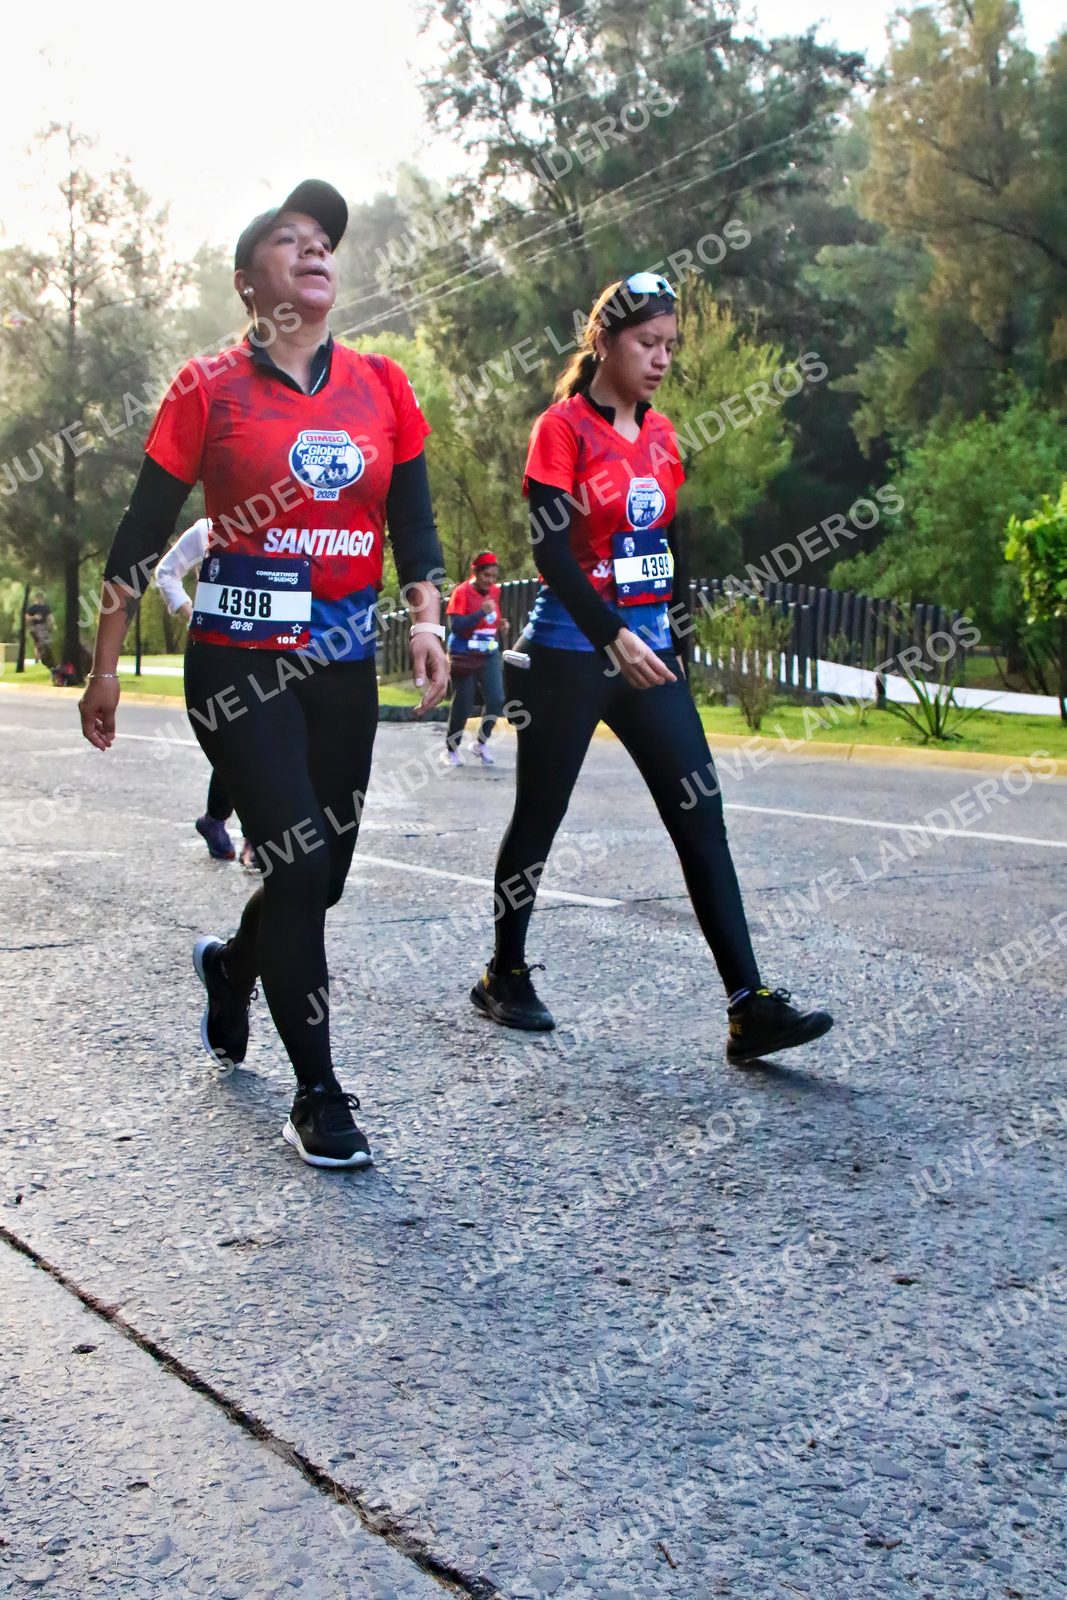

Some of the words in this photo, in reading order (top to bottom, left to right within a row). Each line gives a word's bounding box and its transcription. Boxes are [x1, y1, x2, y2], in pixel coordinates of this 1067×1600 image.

[305, 435, 344, 443] BIMBO
[308, 444, 346, 457] Global
[301, 453, 333, 465] Race
[316, 490, 337, 499] 2026
[263, 527, 374, 557] SANTIAGO
[641, 555, 670, 577] 4399
[256, 570, 299, 578] COMPARTIMOS
[218, 587, 272, 618] 4398
[230, 620, 254, 631] 20-26
[276, 636, 298, 644] 10K
